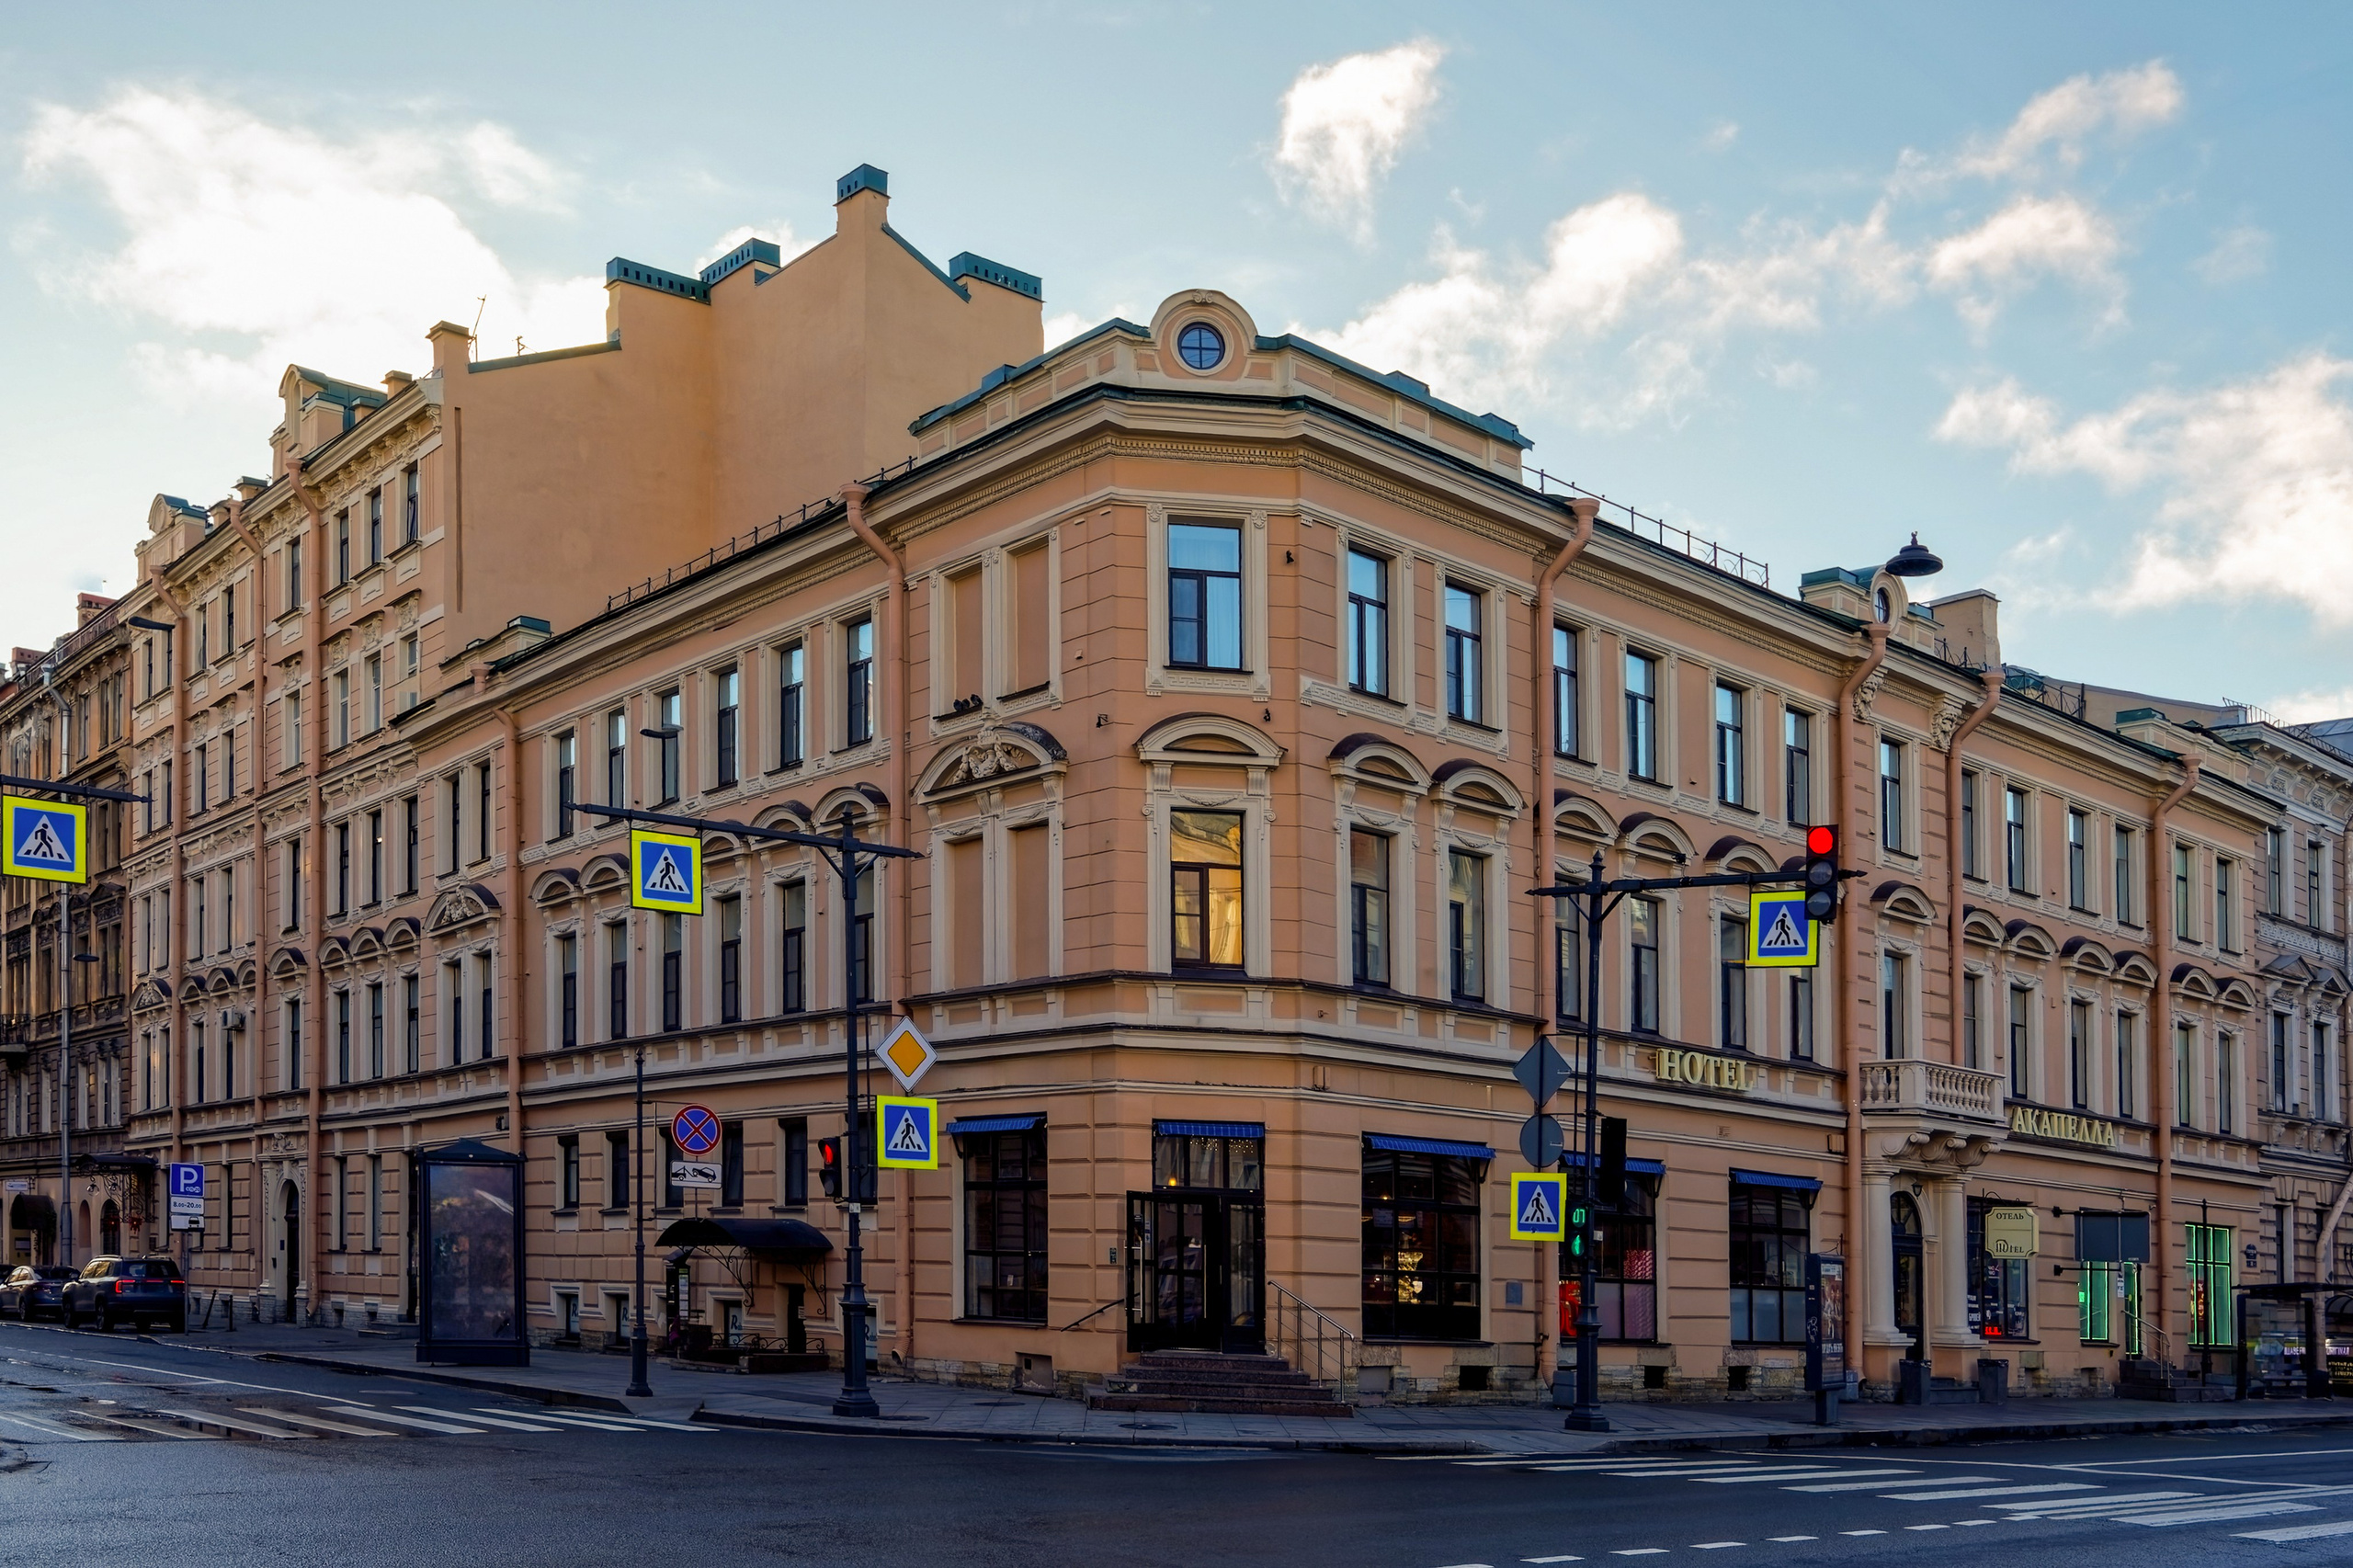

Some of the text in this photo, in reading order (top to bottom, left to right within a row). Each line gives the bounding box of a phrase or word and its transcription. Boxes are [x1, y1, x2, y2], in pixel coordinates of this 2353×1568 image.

[1655, 1048, 1754, 1091] HOTEL
[2012, 1106, 2115, 1147] АКАПЕЛЛА
[180, 1167, 198, 1192] P
[1573, 1208, 1586, 1223] 07
